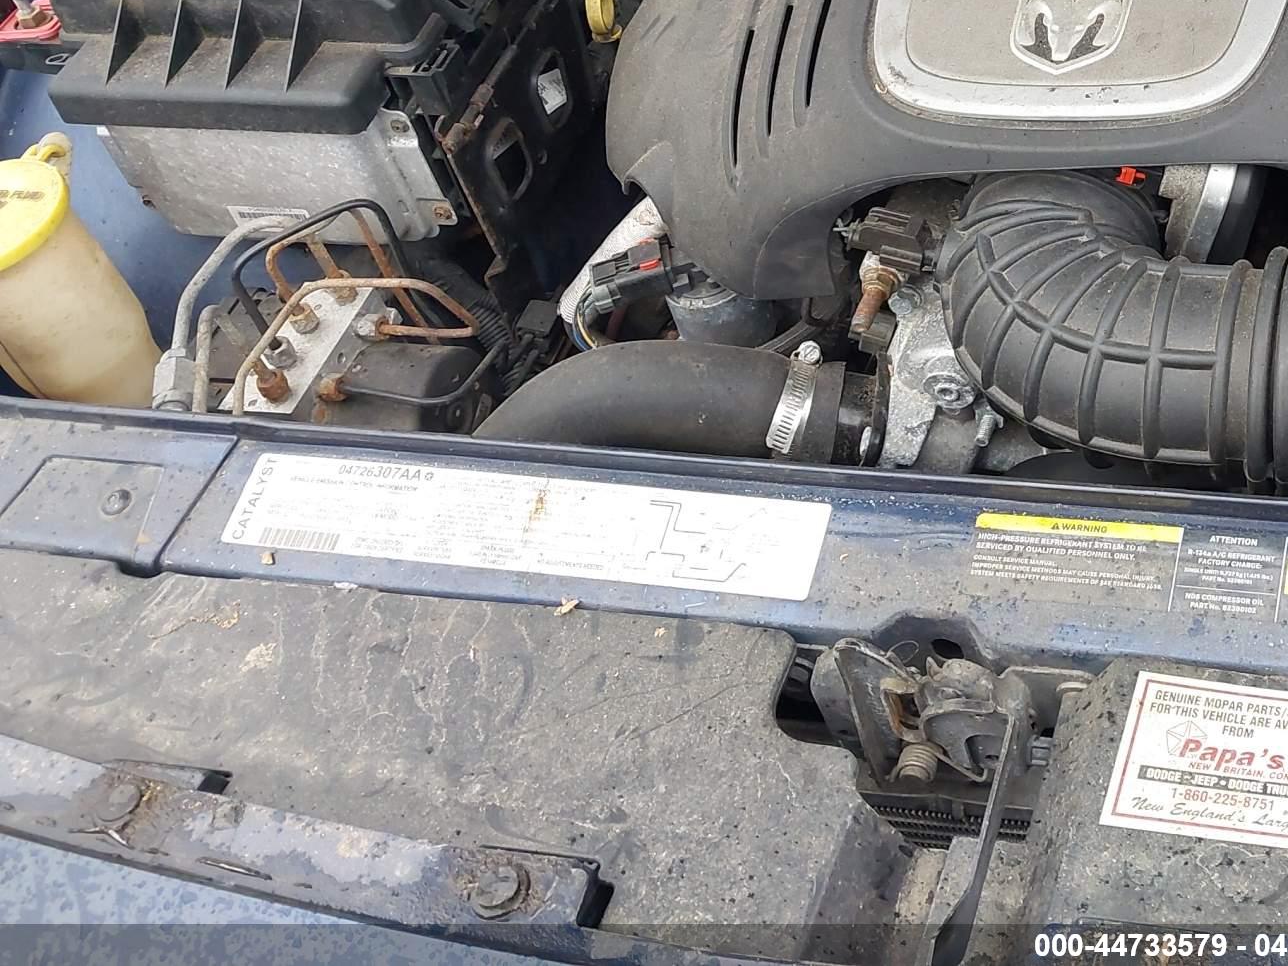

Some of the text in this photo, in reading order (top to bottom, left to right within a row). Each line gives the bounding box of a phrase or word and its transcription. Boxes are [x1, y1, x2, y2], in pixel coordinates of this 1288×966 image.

[231, 457, 277, 539] CATALYST
[1061, 523, 1108, 533] WARNING
[978, 533, 1040, 544] HIGH-PRESSURE
[1209, 535, 1258, 546] ATTENTION
[976, 542, 1136, 561] SERVICED BY QUALIFIED PERSONNEL ONLY.
[1227, 552, 1276, 563] REFRIGERANT
[1198, 558, 1231, 567] FACTORY
[1190, 601, 1209, 609] PART
[1201, 594, 1251, 605] COMPRESSOR
[1252, 598, 1264, 606] OIL
[1154, 689, 1201, 706] GENUINE
[1204, 697, 1243, 712] MOPAR
[1150, 702, 1172, 715] FOR
[1175, 705, 1198, 718] THIS
[1202, 710, 1246, 726] VEHICLE
[1250, 716, 1271, 728] ARE
[1222, 726, 1255, 739] FROM
[1178, 738, 1286, 771] Papa's
[1188, 761, 1211, 771] NEW
[1146, 767, 1182, 783] DODGE
[1190, 774, 1219, 787] JEEP
[1227, 779, 1264, 794] DODGE
[1171, 787, 1275, 811] 1-860-225-8751
[1131, 796, 1164, 811] New
[1170, 802, 1246, 823] England's
